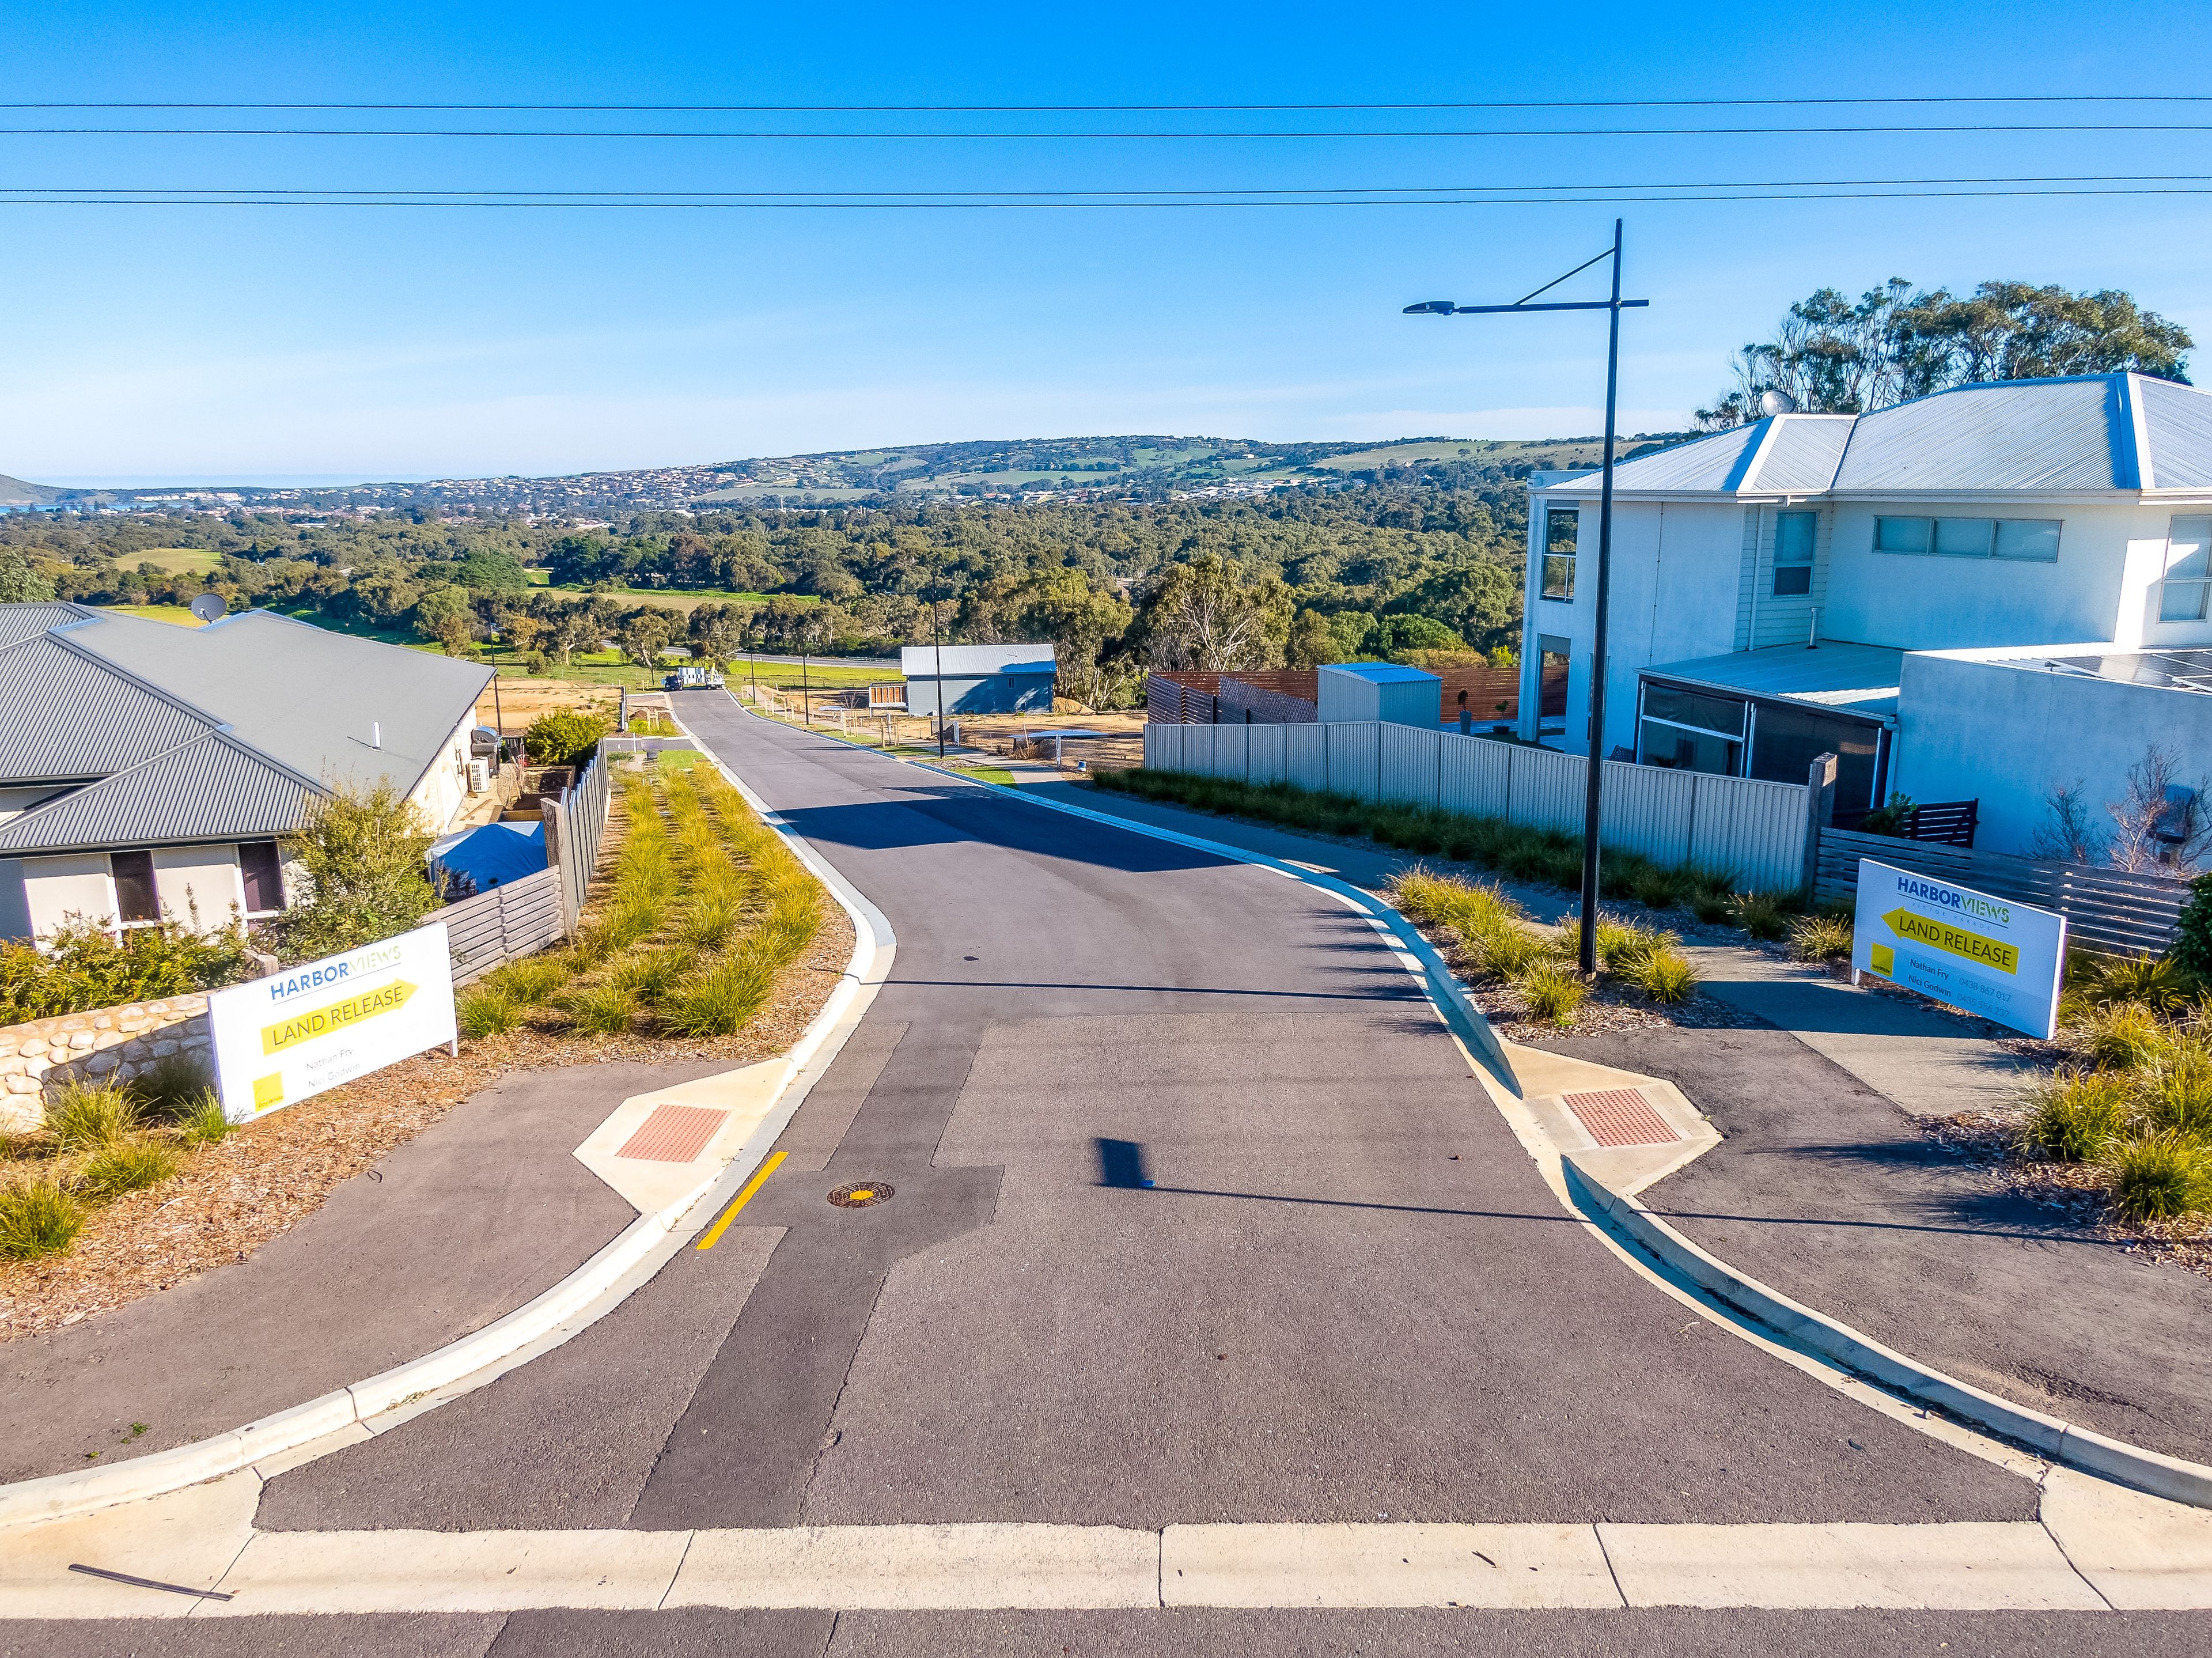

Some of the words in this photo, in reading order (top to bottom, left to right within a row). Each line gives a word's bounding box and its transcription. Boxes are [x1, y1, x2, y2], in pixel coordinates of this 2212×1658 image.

[1897, 876, 2010, 923] HARBORVIEWS
[1899, 916, 1940, 941] LAND
[1944, 930, 2012, 967] RELEASE
[270, 945, 402, 1000] HARBORVIEWS
[1910, 958, 1936, 974] Nathan
[1937, 968, 1949, 981] Fry
[1996, 991, 2012, 1002] 017
[272, 1014, 325, 1046] LAND
[331, 986, 403, 1025] RELEASE
[1908, 974, 1923, 986] Nici
[1923, 980, 1952, 997] Godwin
[1994, 1006, 2009, 1018] 237
[306, 1054, 338, 1071] Nathan
[340, 1048, 353, 1061] Fry
[308, 1074, 325, 1088] Nici
[327, 1063, 361, 1081] Godwin
